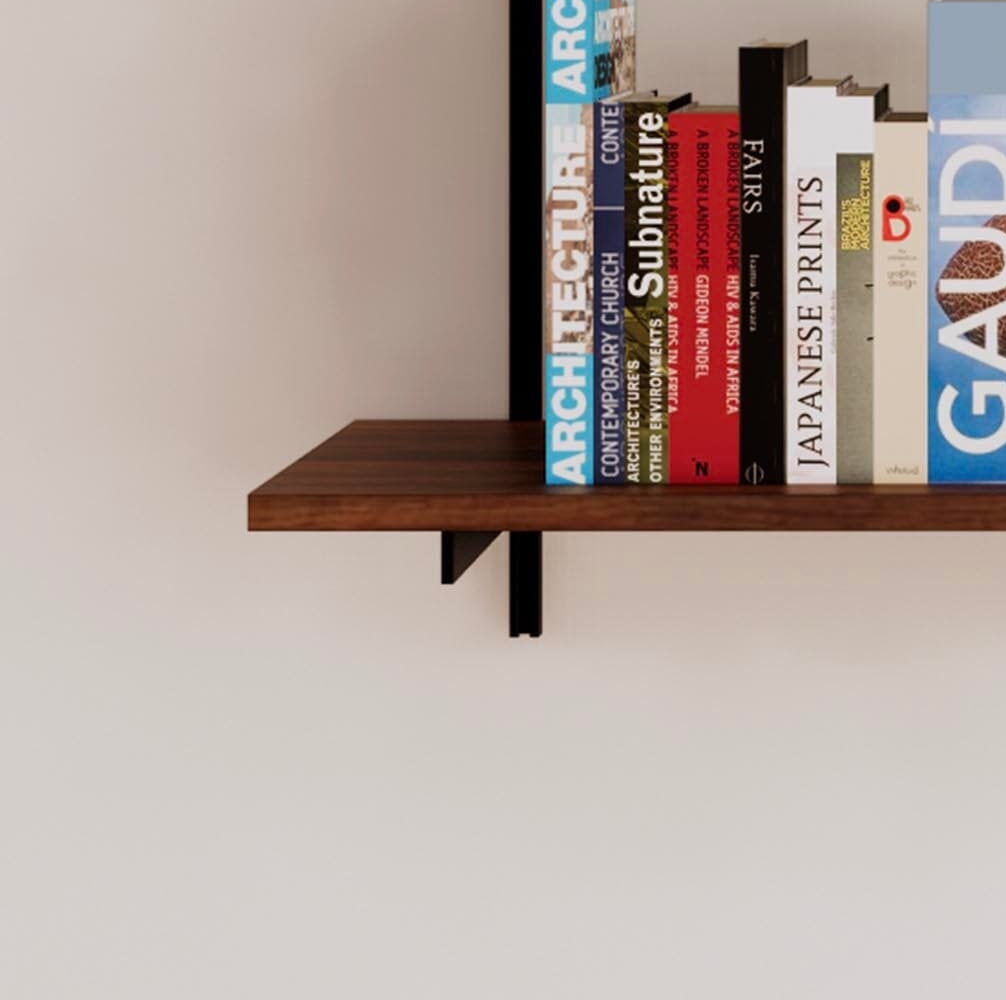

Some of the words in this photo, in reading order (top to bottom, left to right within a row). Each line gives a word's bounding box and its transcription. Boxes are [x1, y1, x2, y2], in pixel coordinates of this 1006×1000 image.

[600, 101, 620, 165] CONTE
[696, 128, 709, 138] A
[727, 128, 739, 138] A
[696, 142, 709, 193] BROKEN
[727, 142, 739, 193] BROKEN
[743, 138, 765, 214] FAIRS
[627, 112, 664, 299] Subnature
[850, 198, 861, 250] MODERN
[860, 160, 871, 250] ARCHITECTURE
[696, 197, 709, 272] LANDSCAPE
[727, 197, 739, 272] LANDSCAPE
[797, 176, 824, 294] PRINTS
[551, 123, 588, 485] ARCHITECTURE
[600, 252, 620, 326] CHURCH
[696, 275, 709, 324] GIDEON
[727, 275, 739, 300] HIV
[727, 302, 739, 312] &
[696, 328, 709, 379] MENDEL
[727, 315, 739, 346] AIDS
[727, 349, 739, 365] IN
[649, 318, 663, 430] ENVIRONMENTS
[727, 367, 739, 415] AFRICA
[797, 305, 829, 468] JAPANESE
[600, 330, 620, 478] CONTEMPORARY
[627, 359, 641, 484] ARCHITECTURE'S
[649, 434, 663, 483] OTHER
